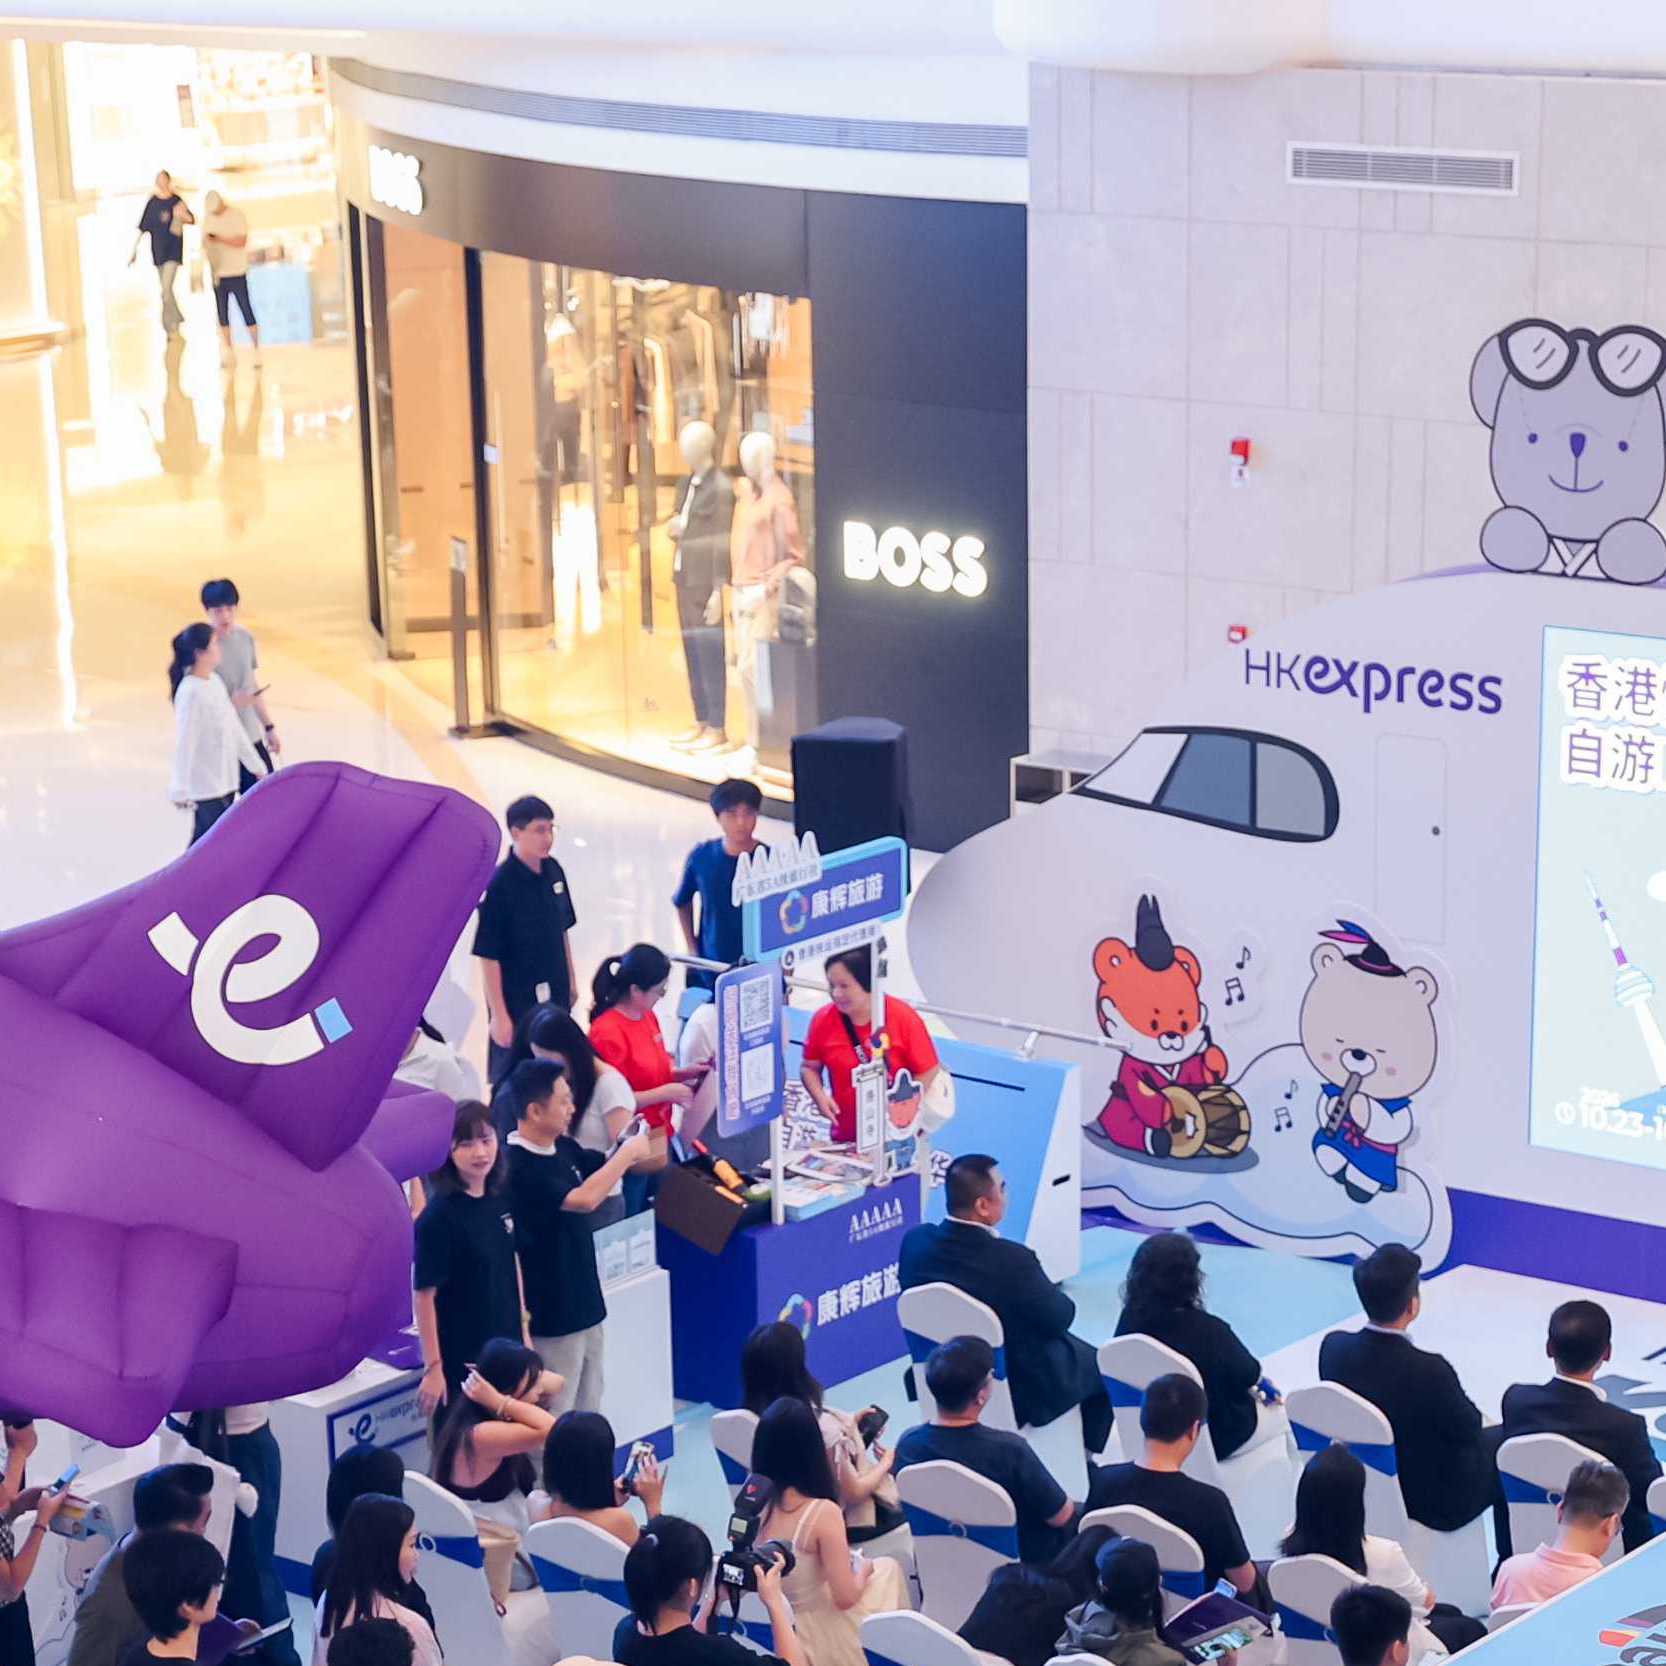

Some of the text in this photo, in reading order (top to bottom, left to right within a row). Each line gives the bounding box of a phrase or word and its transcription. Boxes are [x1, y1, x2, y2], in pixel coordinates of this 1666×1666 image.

[842, 520, 989, 599] BOSS
[1244, 648, 1503, 714] HKexpress
[811, 872, 884, 919] 康辉旅游
